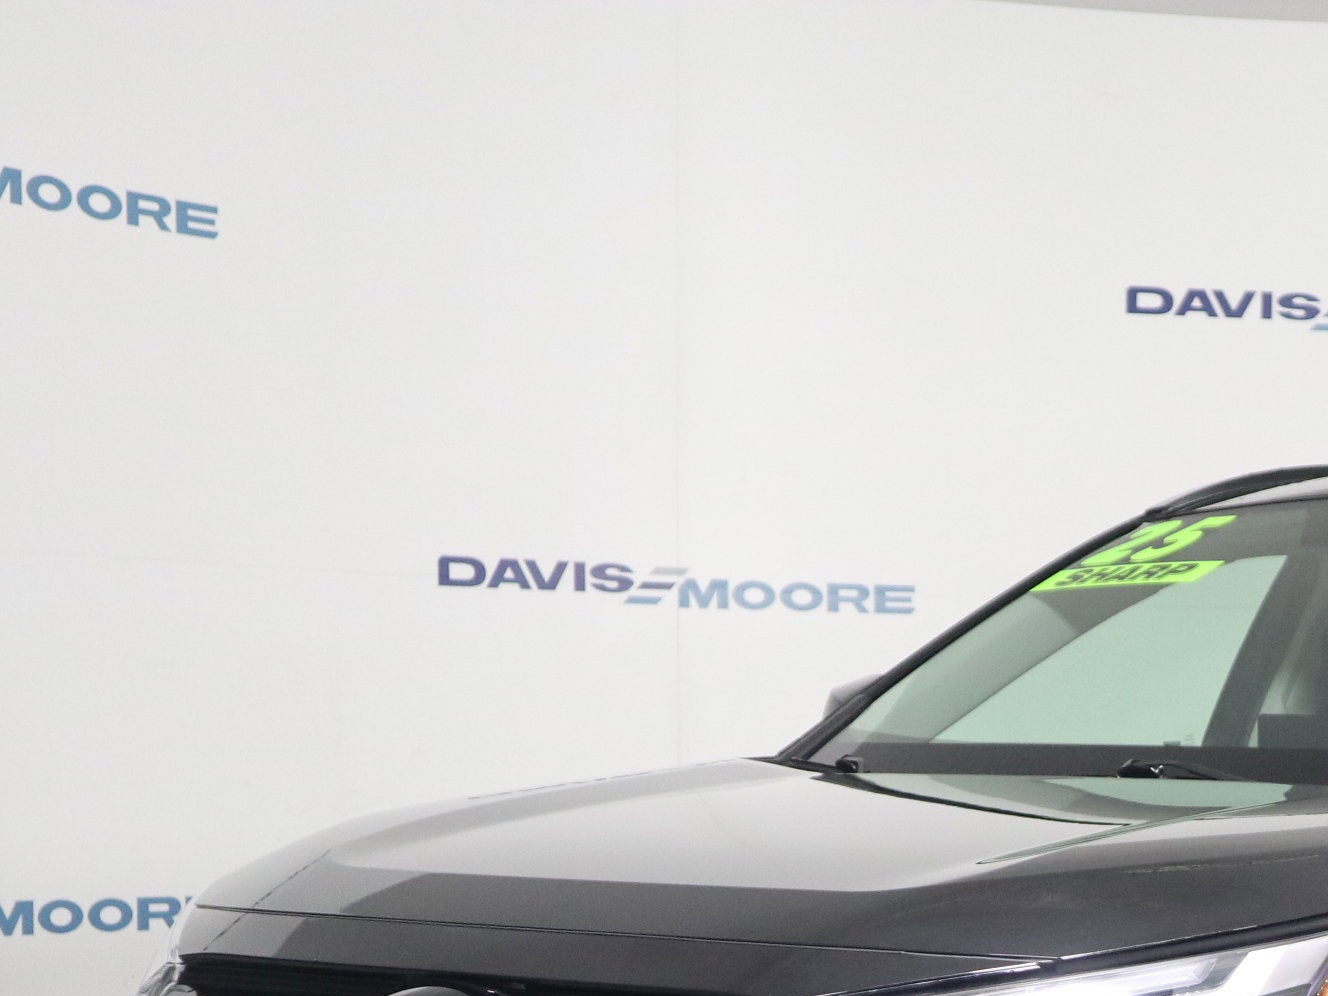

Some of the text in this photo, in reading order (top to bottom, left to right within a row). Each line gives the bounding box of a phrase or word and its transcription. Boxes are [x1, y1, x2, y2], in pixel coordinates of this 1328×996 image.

[1126, 285, 1321, 320] DAVIS
[1081, 515, 1237, 566] 25
[437, 555, 916, 615] DAVIS MOORE
[1055, 562, 1199, 587] SHARP
[0, 896, 192, 936] MOOR
